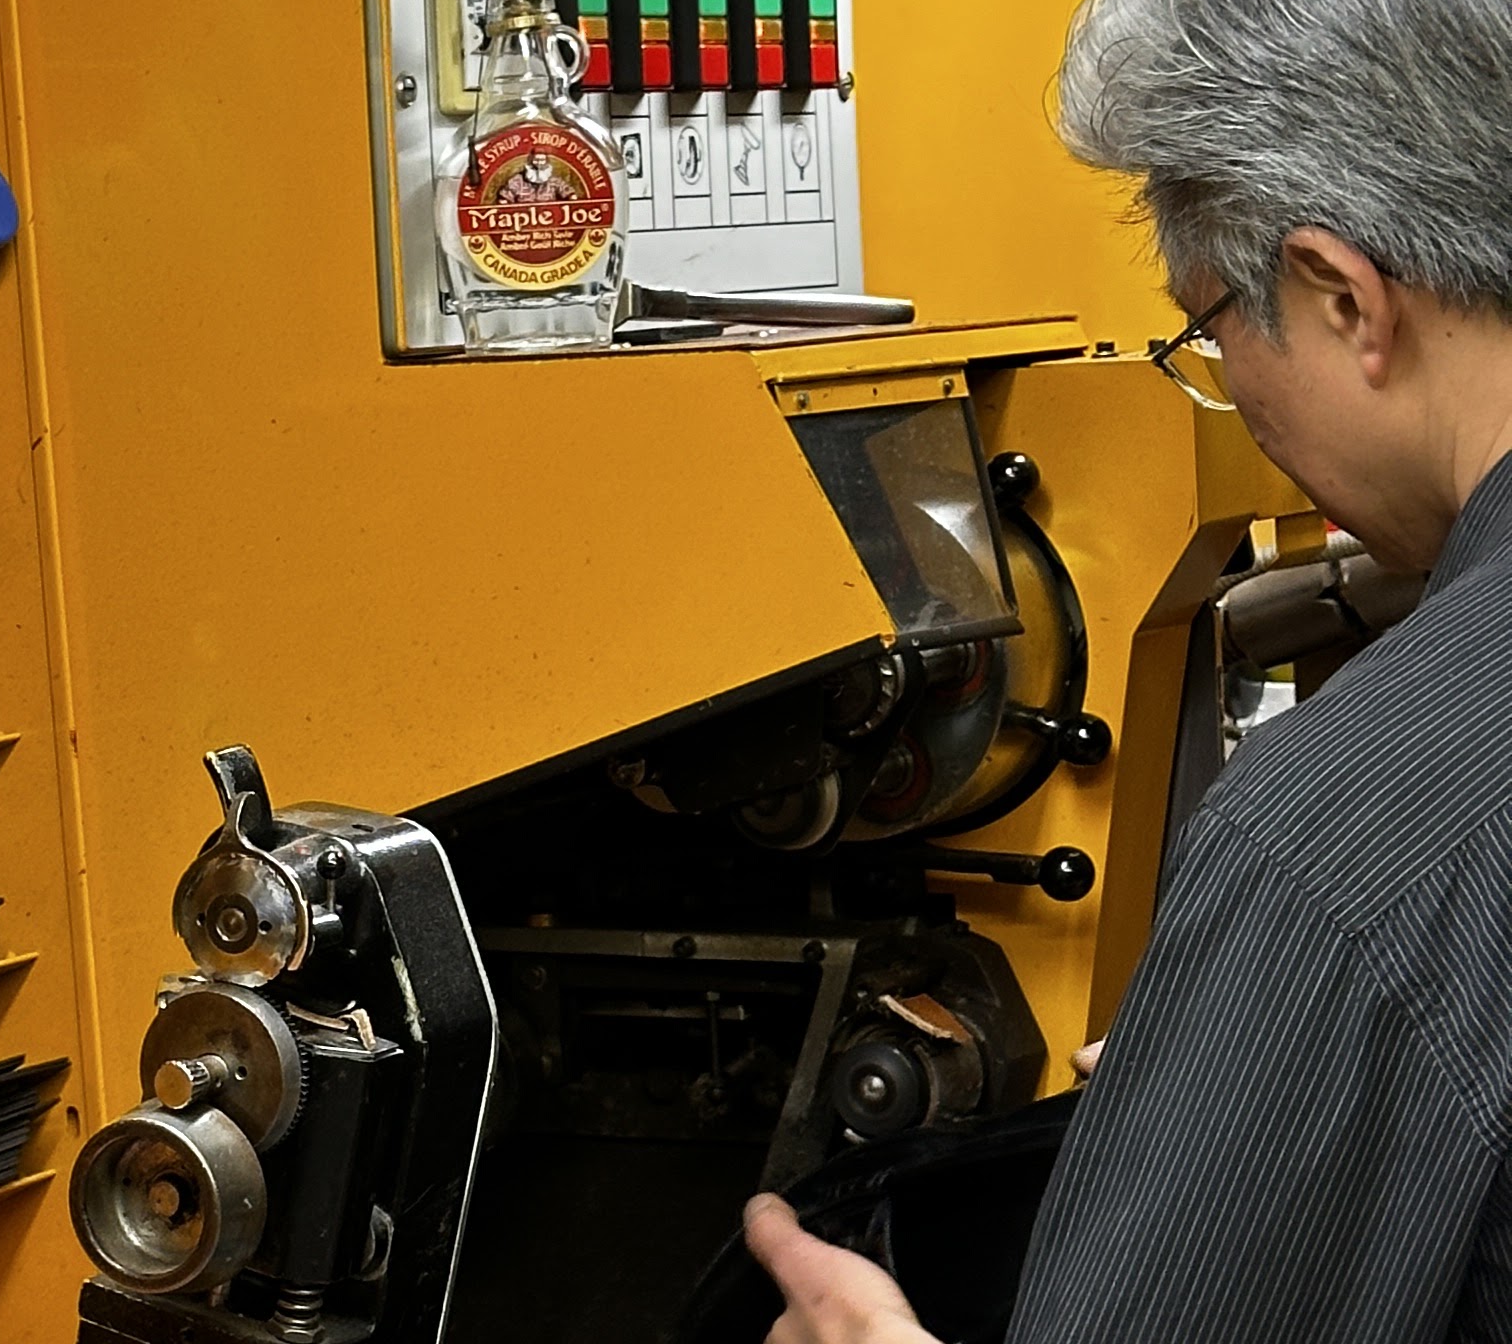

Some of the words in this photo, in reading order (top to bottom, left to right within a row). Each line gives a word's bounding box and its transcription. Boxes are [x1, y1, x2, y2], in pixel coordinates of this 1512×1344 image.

[484, 134, 521, 163] SYRUP
[530, 131, 568, 148] SIROP
[468, 206, 554, 232] Maple
[483, 253, 539, 284] CANADA
[539, 256, 585, 284] GRADE
[582, 250, 594, 265] A
